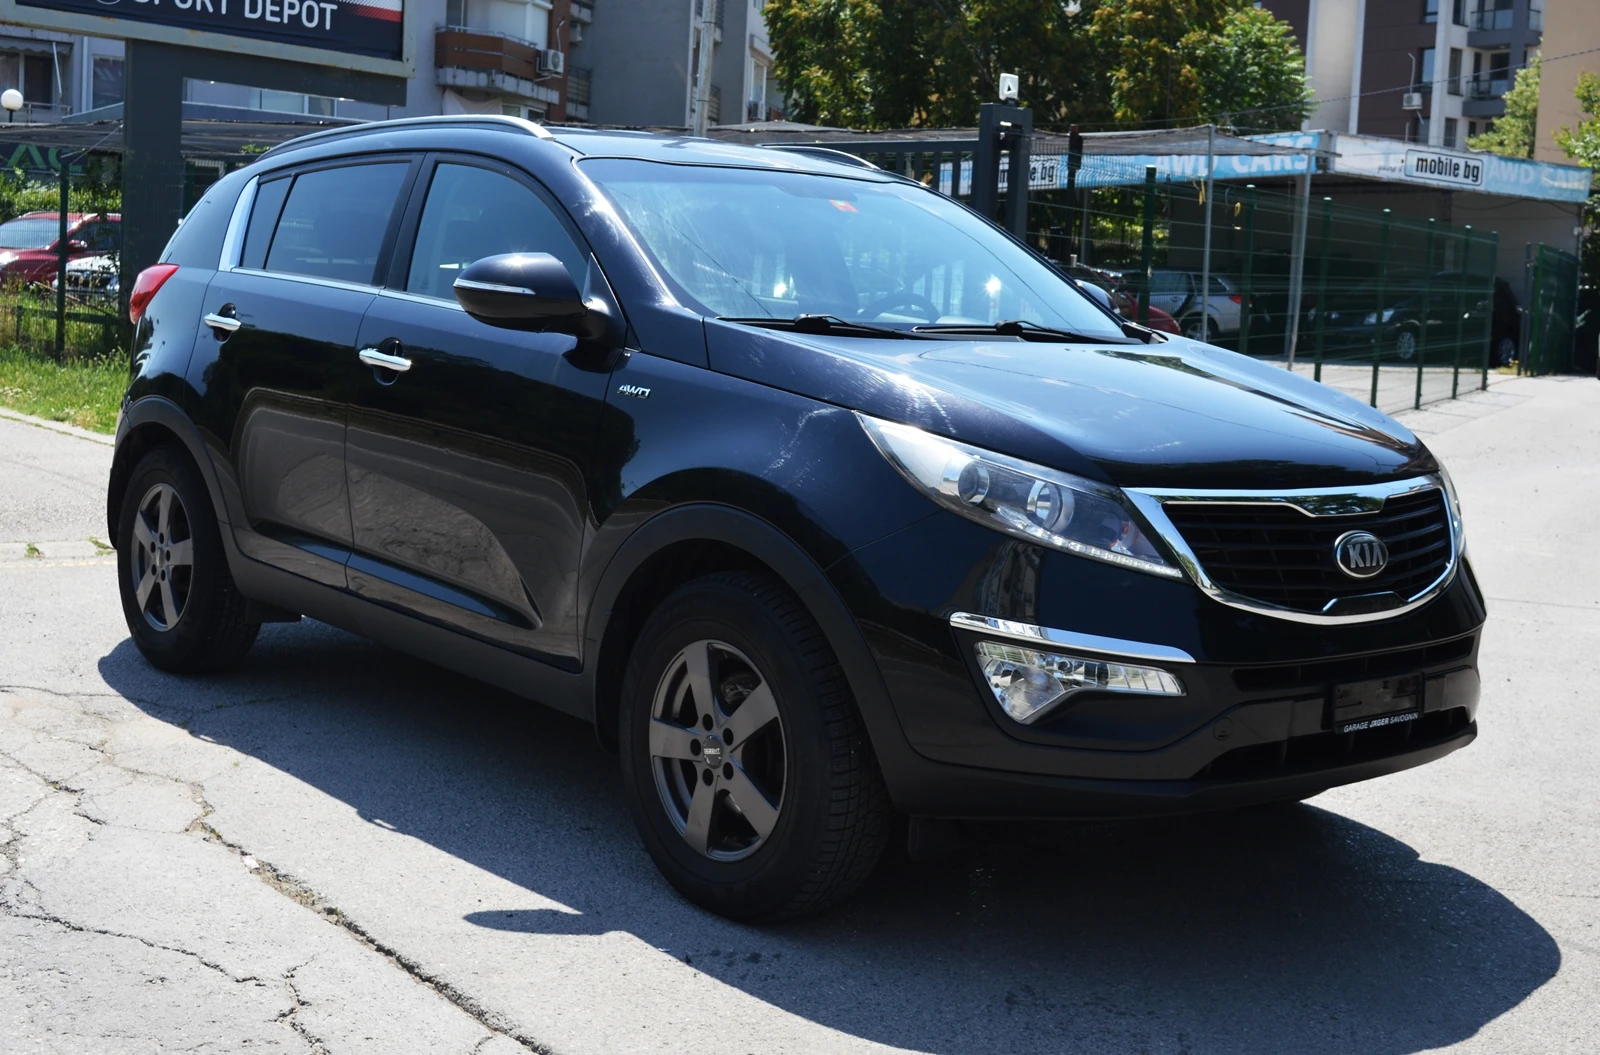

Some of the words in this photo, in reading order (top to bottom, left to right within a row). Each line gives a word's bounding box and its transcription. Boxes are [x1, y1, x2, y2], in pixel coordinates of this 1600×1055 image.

[243, 0, 338, 31] DEPOT
[1415, 156, 1460, 178] mobile
[1463, 160, 1480, 183] bg
[1489, 160, 1535, 185] AWD
[1346, 542, 1384, 568] KIA
[1343, 721, 1369, 733] GARAGE
